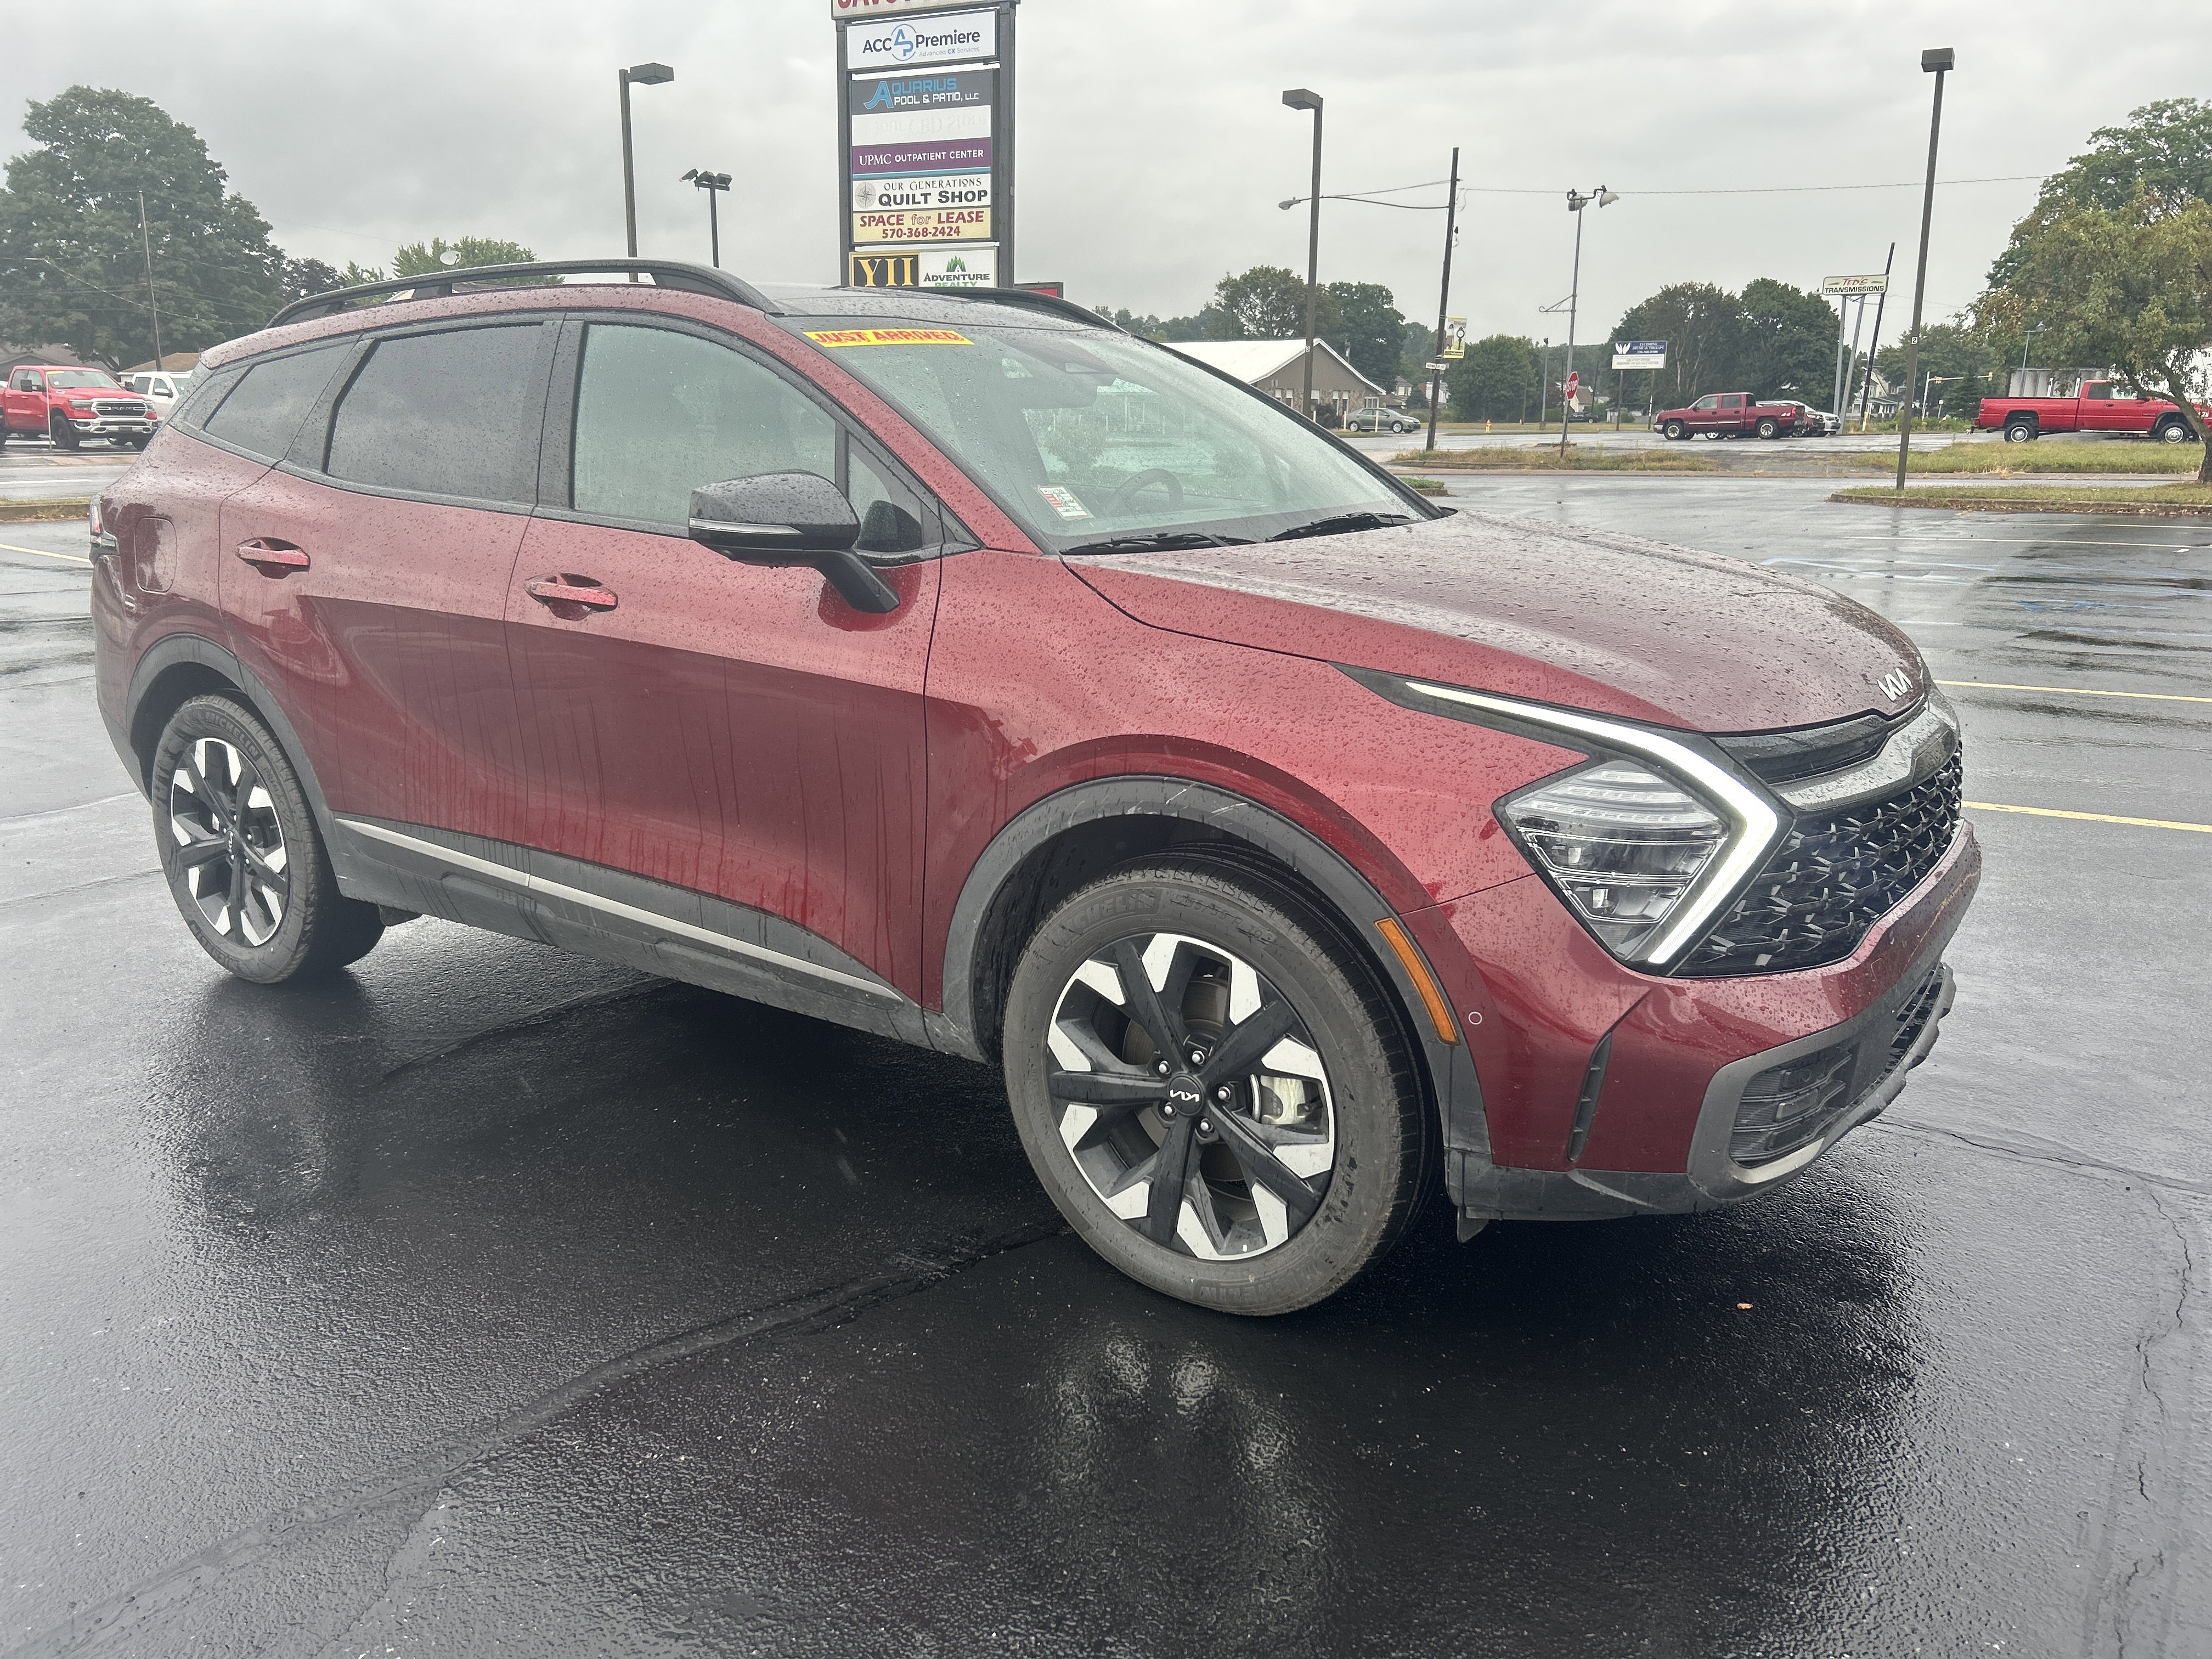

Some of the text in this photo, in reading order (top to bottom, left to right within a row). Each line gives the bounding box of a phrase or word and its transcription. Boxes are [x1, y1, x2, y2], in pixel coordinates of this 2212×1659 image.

[862, 37, 892, 54] ACC
[916, 30, 980, 48] Premiere
[918, 49, 946, 57] Advanced
[864, 77, 958, 109] AQUARIUS
[894, 94, 920, 106] POOL
[922, 94, 930, 103] &
[933, 92, 963, 103] PATIO,
[859, 149, 984, 166] UPMC OUTPATIENT CENTER
[884, 182, 904, 191] OUR
[878, 189, 988, 207] QUILT SHOP
[859, 211, 984, 228] SPACE for LEASE
[882, 227, 961, 239] 570-368-2424
[923, 272, 990, 282] ADVENTURE
[1825, 285, 1884, 294] TRANSMISSIONS
[815, 330, 963, 343] JUST ARRIVED
[1567, 380, 1578, 392] STOP
[205, 711, 259, 760] MICHELIN
